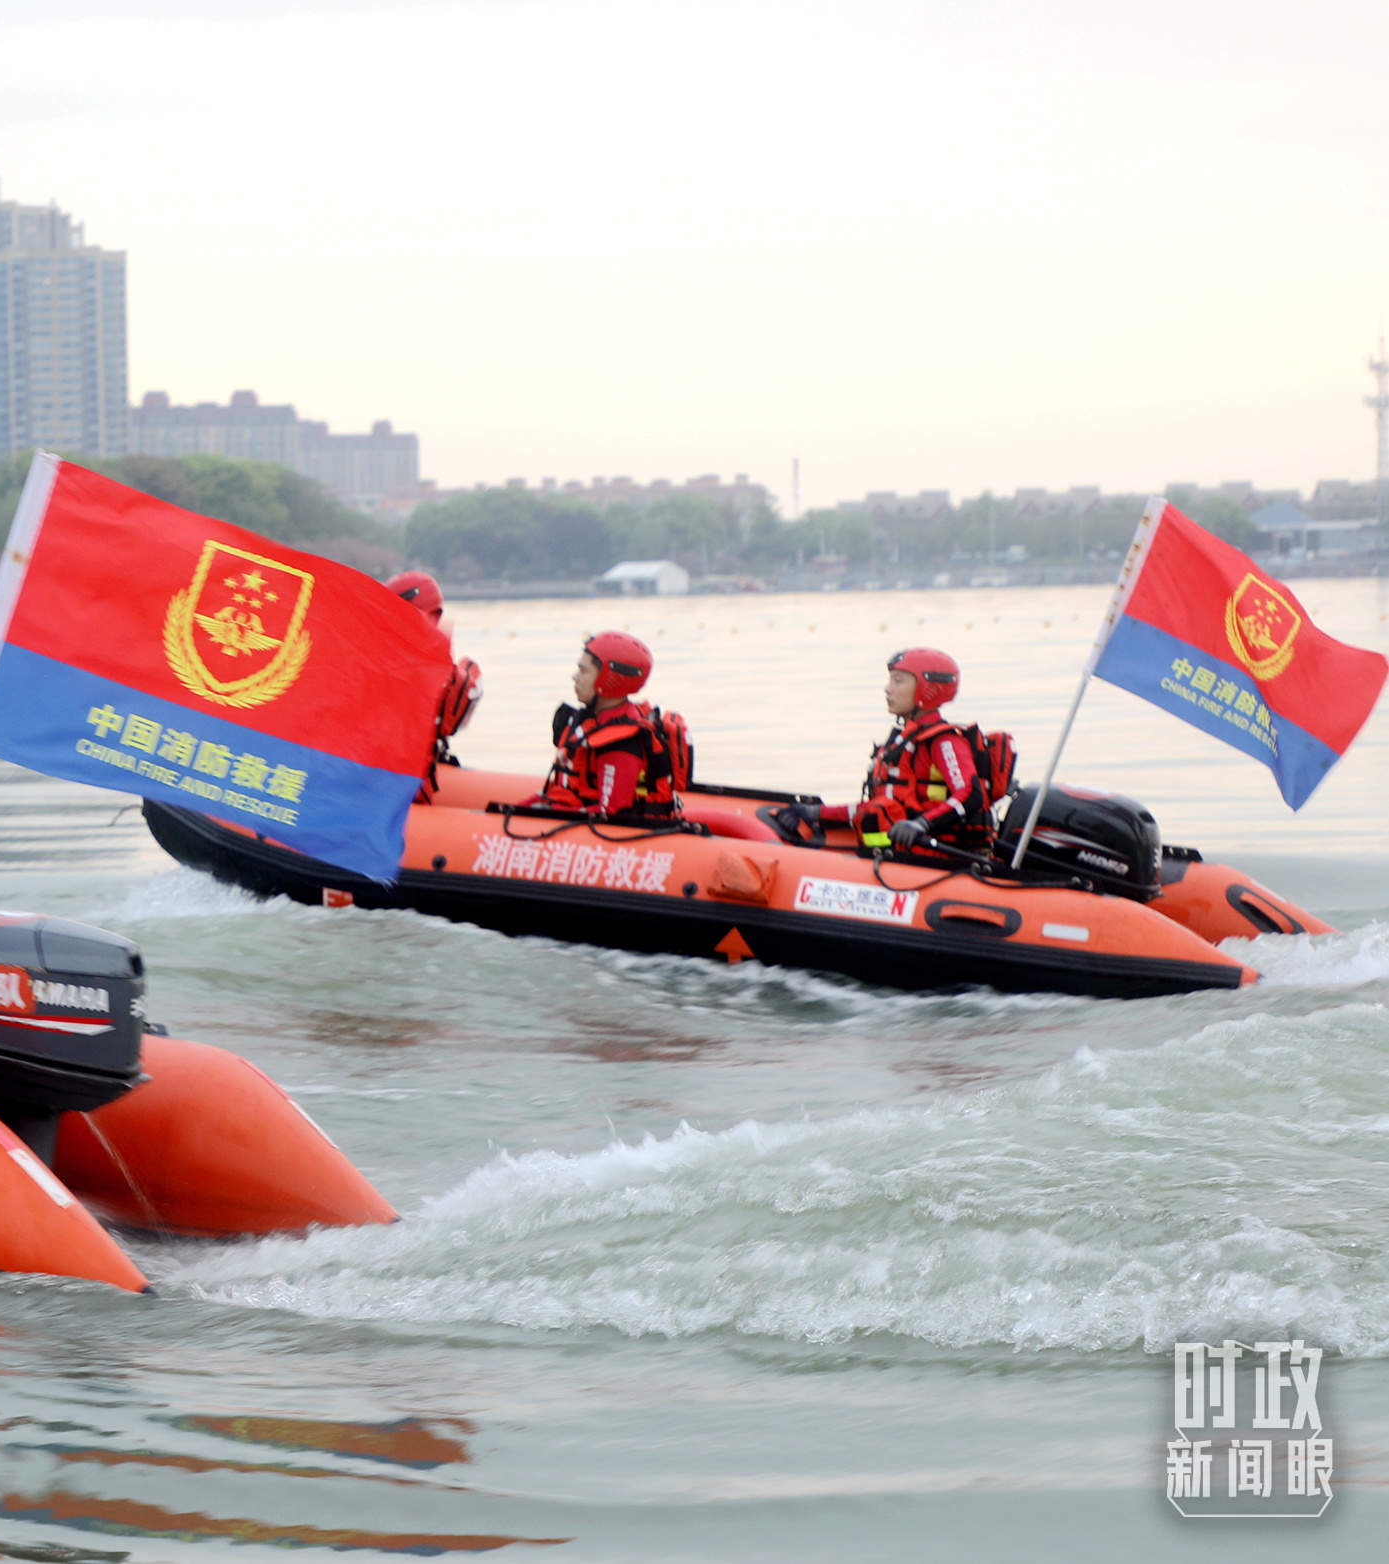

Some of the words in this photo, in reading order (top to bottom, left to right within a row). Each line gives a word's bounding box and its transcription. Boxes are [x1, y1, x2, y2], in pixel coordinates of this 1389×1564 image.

[1161, 677, 1197, 704] CHINA
[1199, 696, 1223, 718] FIRE
[1223, 710, 1250, 730] AND
[1172, 658, 1278, 737] 中国消防救
[75, 738, 138, 772] CHINA
[136, 760, 181, 786] FIRE
[179, 775, 224, 801] AND
[224, 789, 301, 827] RESCUE
[85, 703, 309, 804] 中国消防救援
[472, 834, 675, 893] 湖南消防救援
